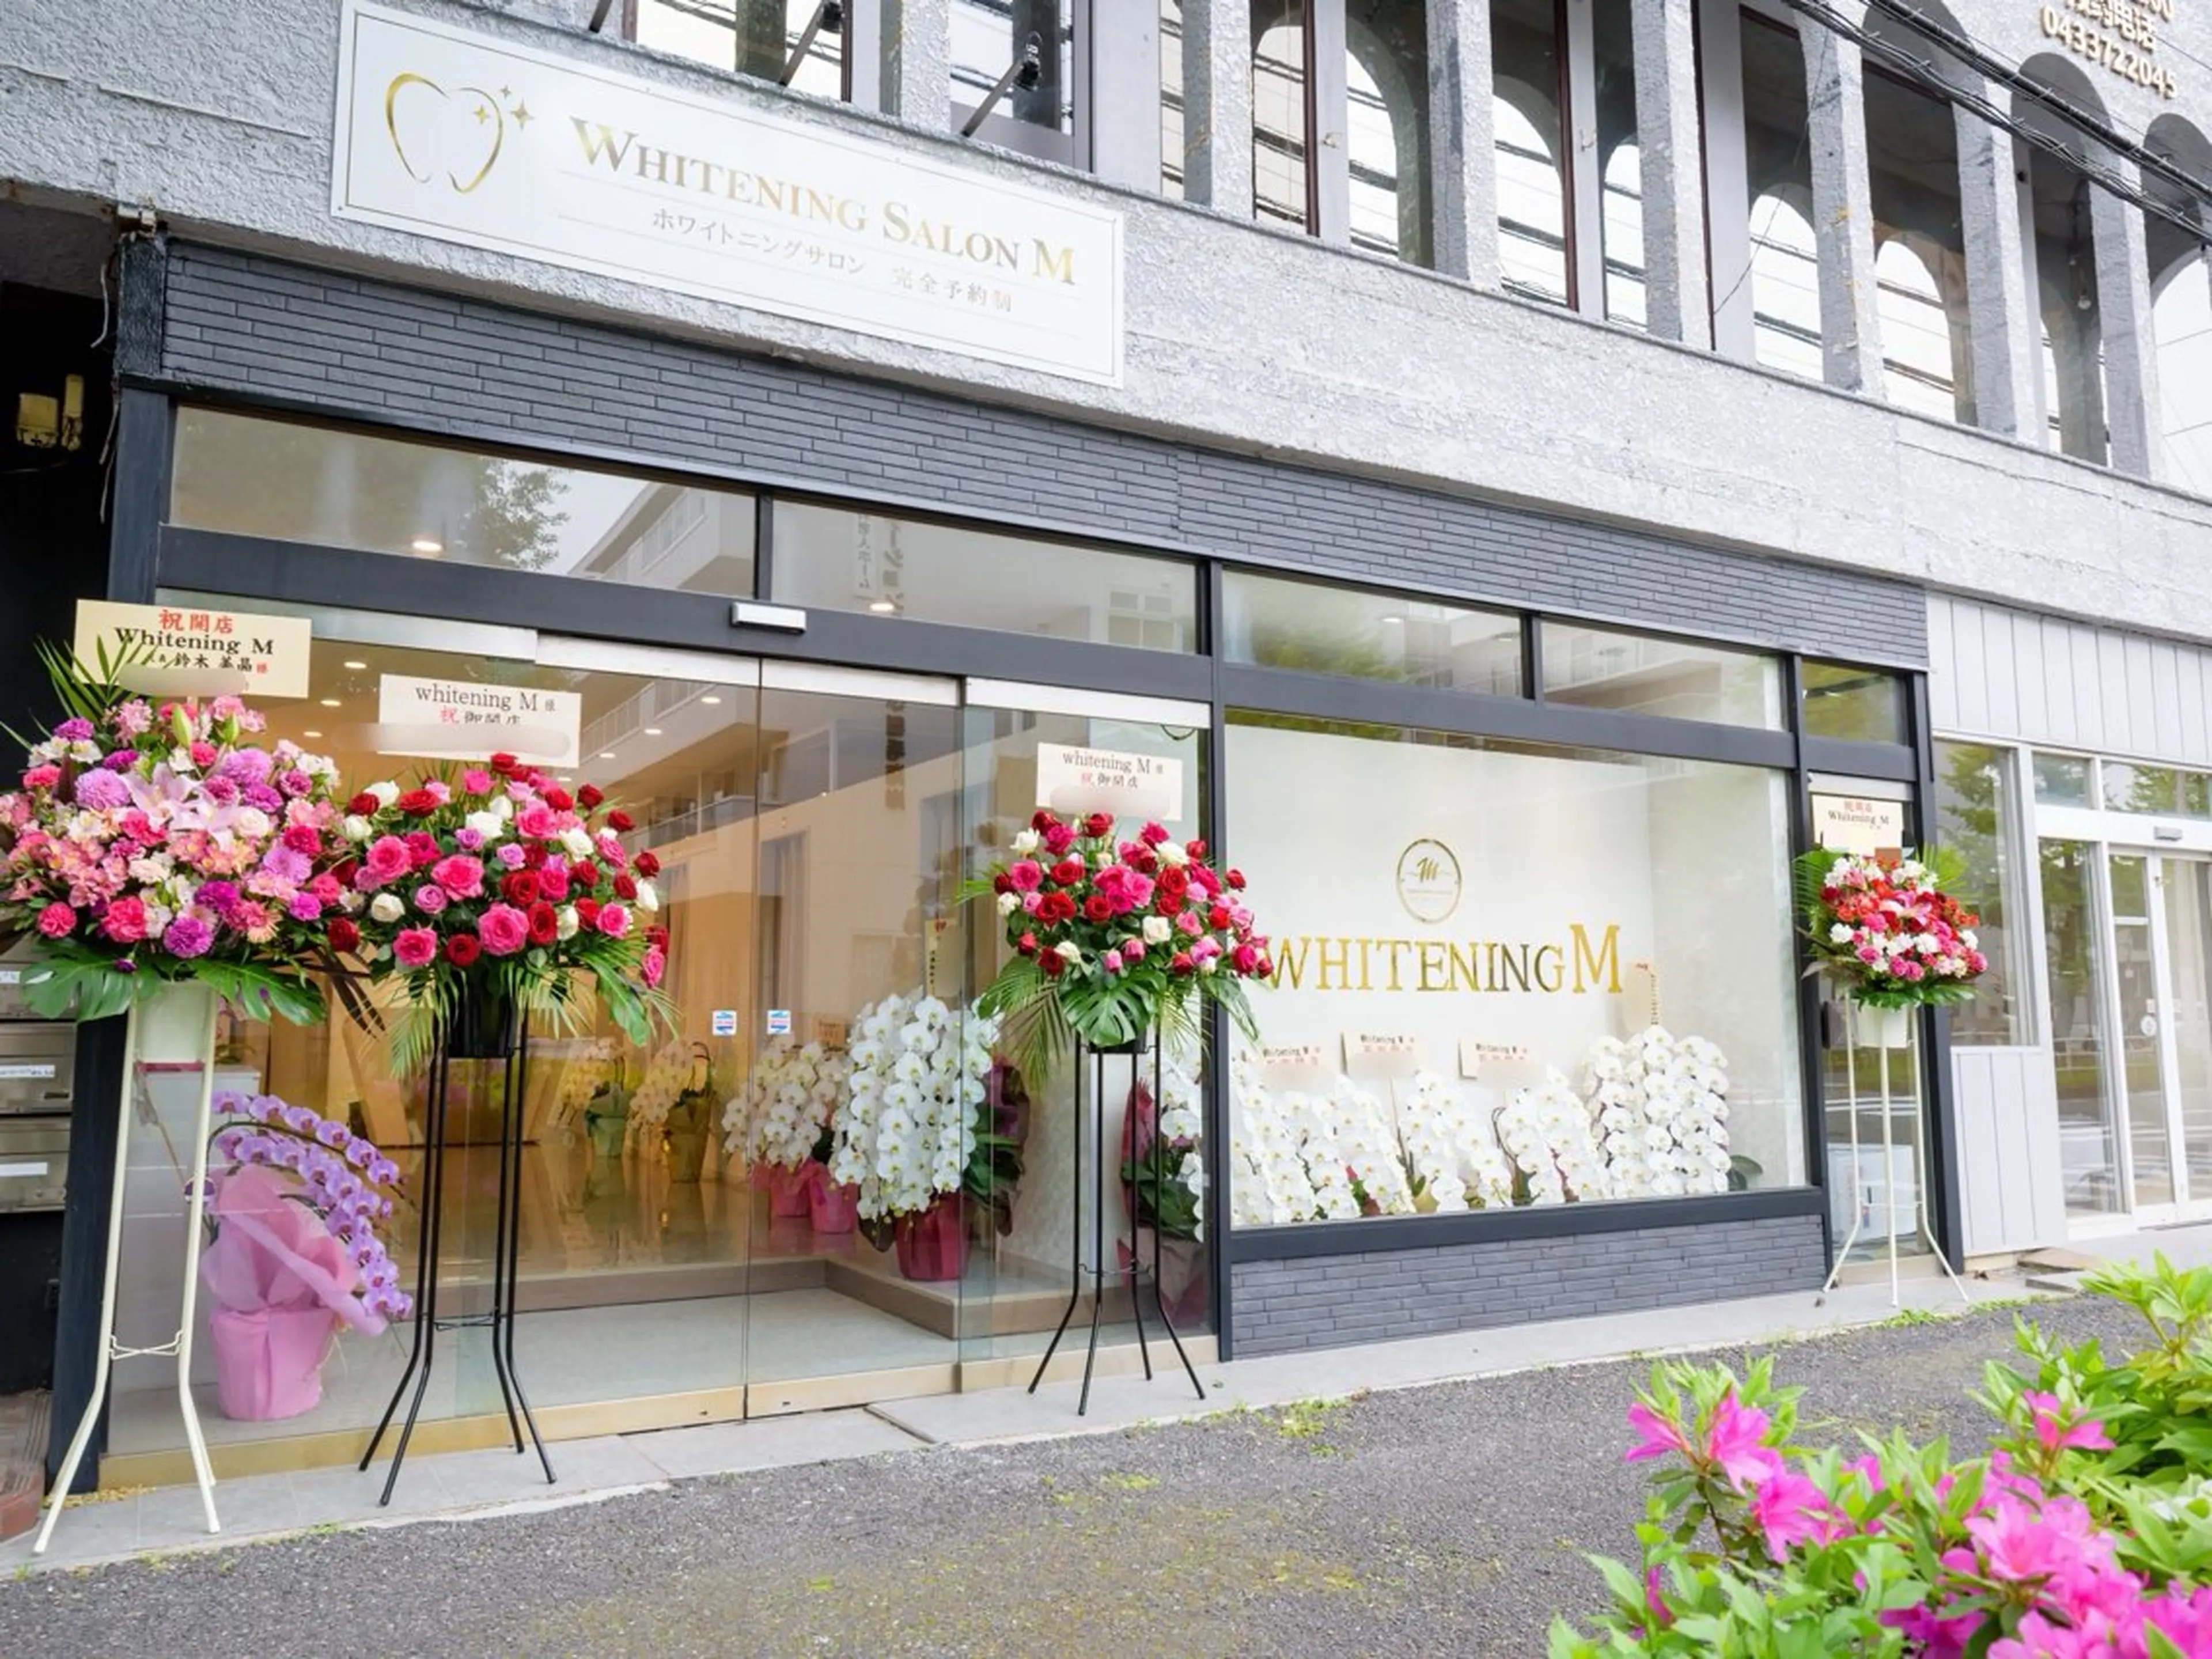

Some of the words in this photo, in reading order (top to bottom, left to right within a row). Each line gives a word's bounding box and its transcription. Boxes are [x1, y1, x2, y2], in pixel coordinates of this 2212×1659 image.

[2041, 5, 2178, 99] 0433722045
[653, 207, 866, 274] ホワイトニングサロン
[892, 266, 1012, 312] 完全予約制
[1032, 238, 1075, 286] M
[159, 609, 234, 633] 祝開店
[115, 627, 241, 655] Whitening
[252, 638, 274, 655] M
[415, 684, 512, 712] whitening
[520, 692, 538, 711] M
[1063, 751, 1132, 773] whitening
[1137, 757, 1150, 774] M
